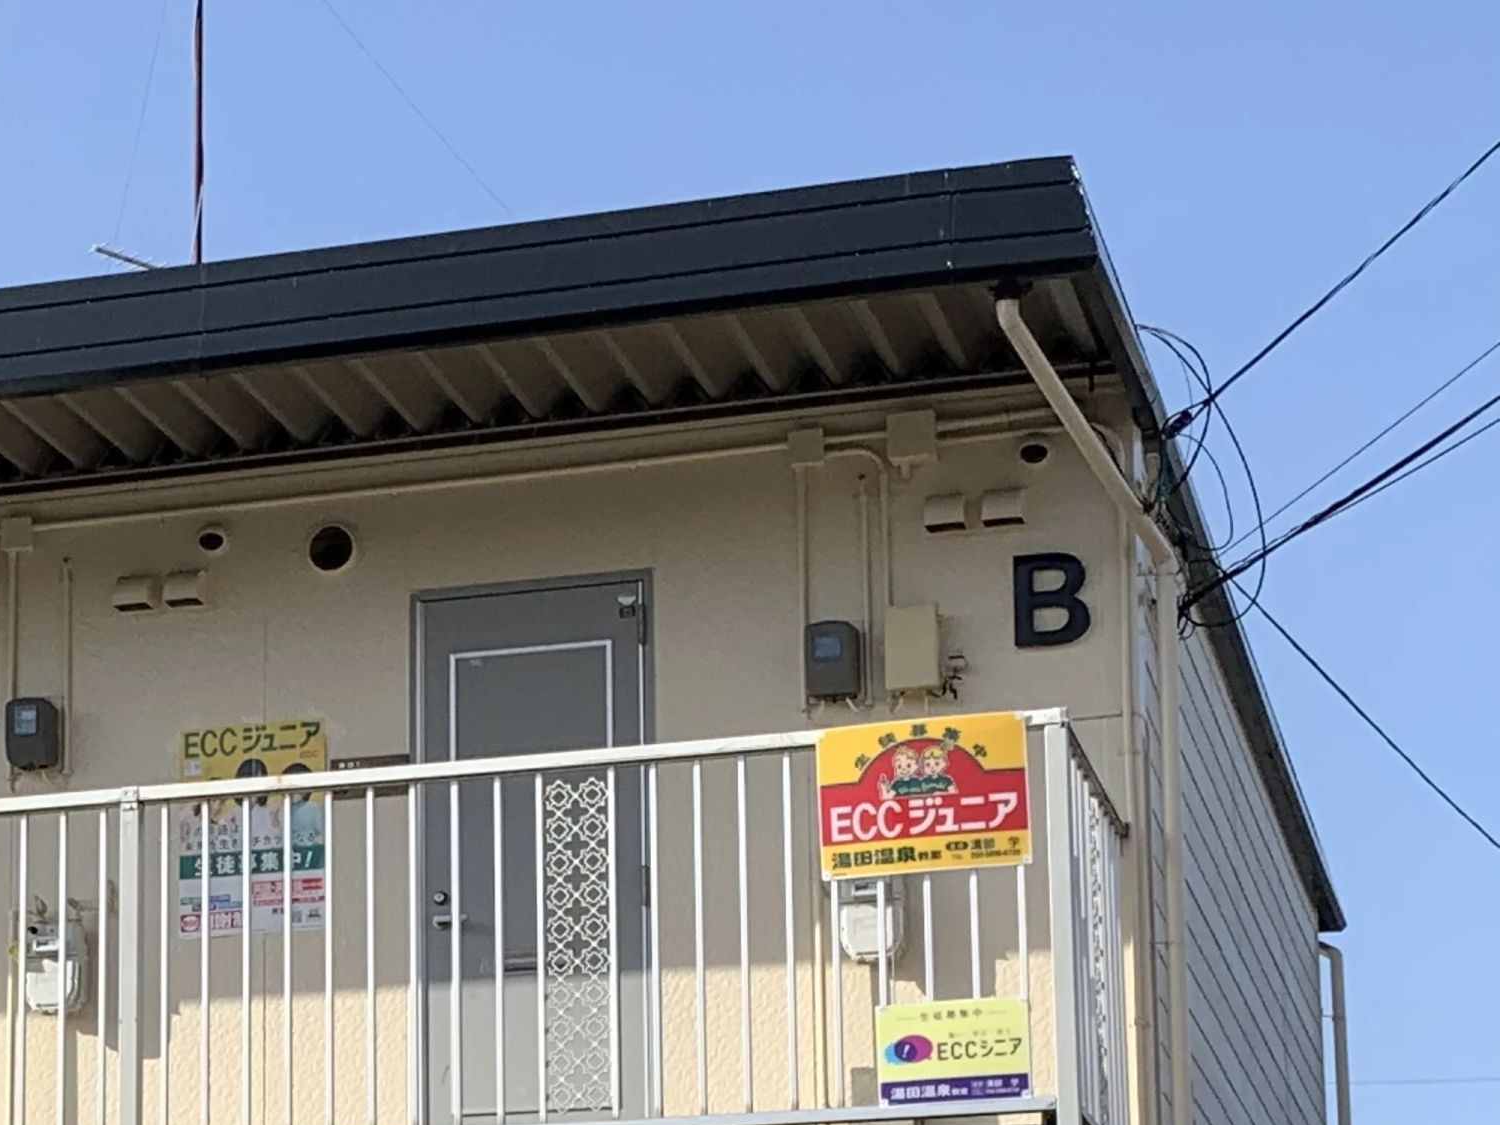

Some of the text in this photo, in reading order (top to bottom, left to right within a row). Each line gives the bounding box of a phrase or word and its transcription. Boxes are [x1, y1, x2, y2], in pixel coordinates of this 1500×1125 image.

[1013, 552, 1091, 648] B
[184, 721, 321, 760] ECCジュニア
[830, 791, 1018, 843] ECCジュニア
[937, 1037, 1022, 1061] ECCシニア
